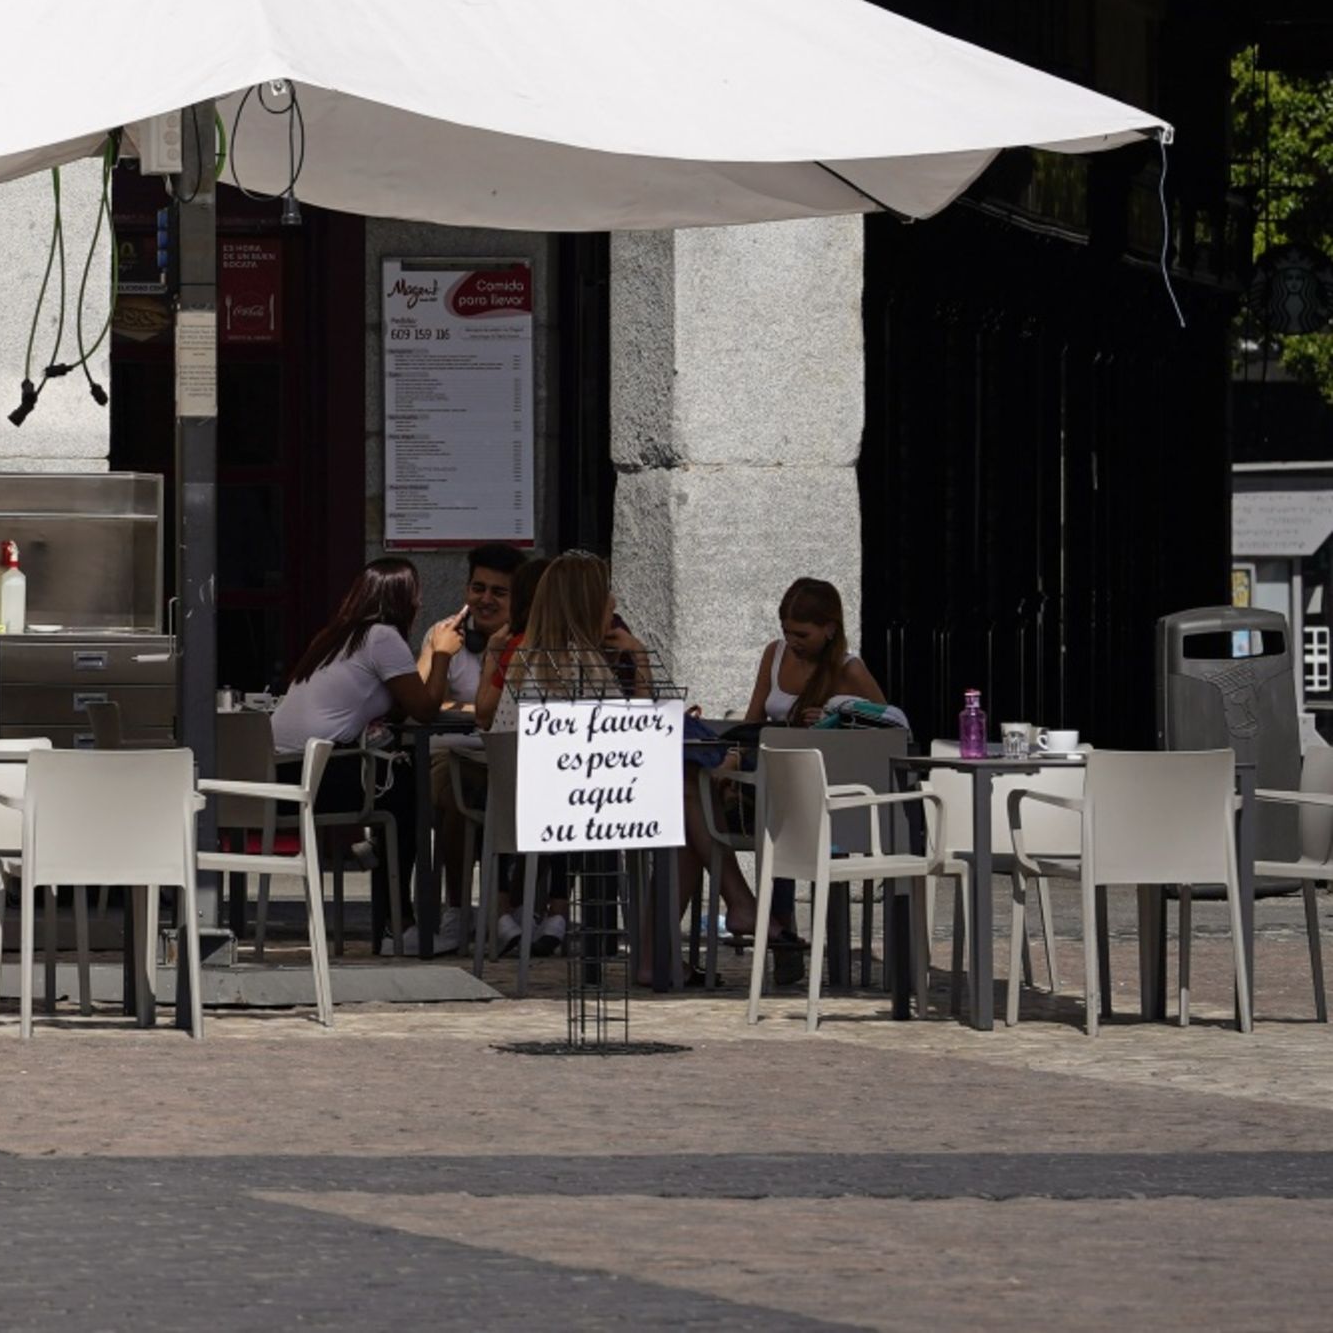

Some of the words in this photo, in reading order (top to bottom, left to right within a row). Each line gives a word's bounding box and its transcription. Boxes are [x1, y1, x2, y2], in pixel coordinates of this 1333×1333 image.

[475, 278, 525, 292] Comida
[458, 295, 488, 308] para
[490, 293, 525, 306] llevar
[390, 328, 410, 340] 609
[414, 328, 432, 340] 159
[524, 707, 578, 736] Por
[586, 705, 675, 743] favor,
[556, 750, 644, 778] espere
[568, 777, 638, 813] aquí
[540, 822, 578, 843] su
[584, 816, 662, 841] turno
